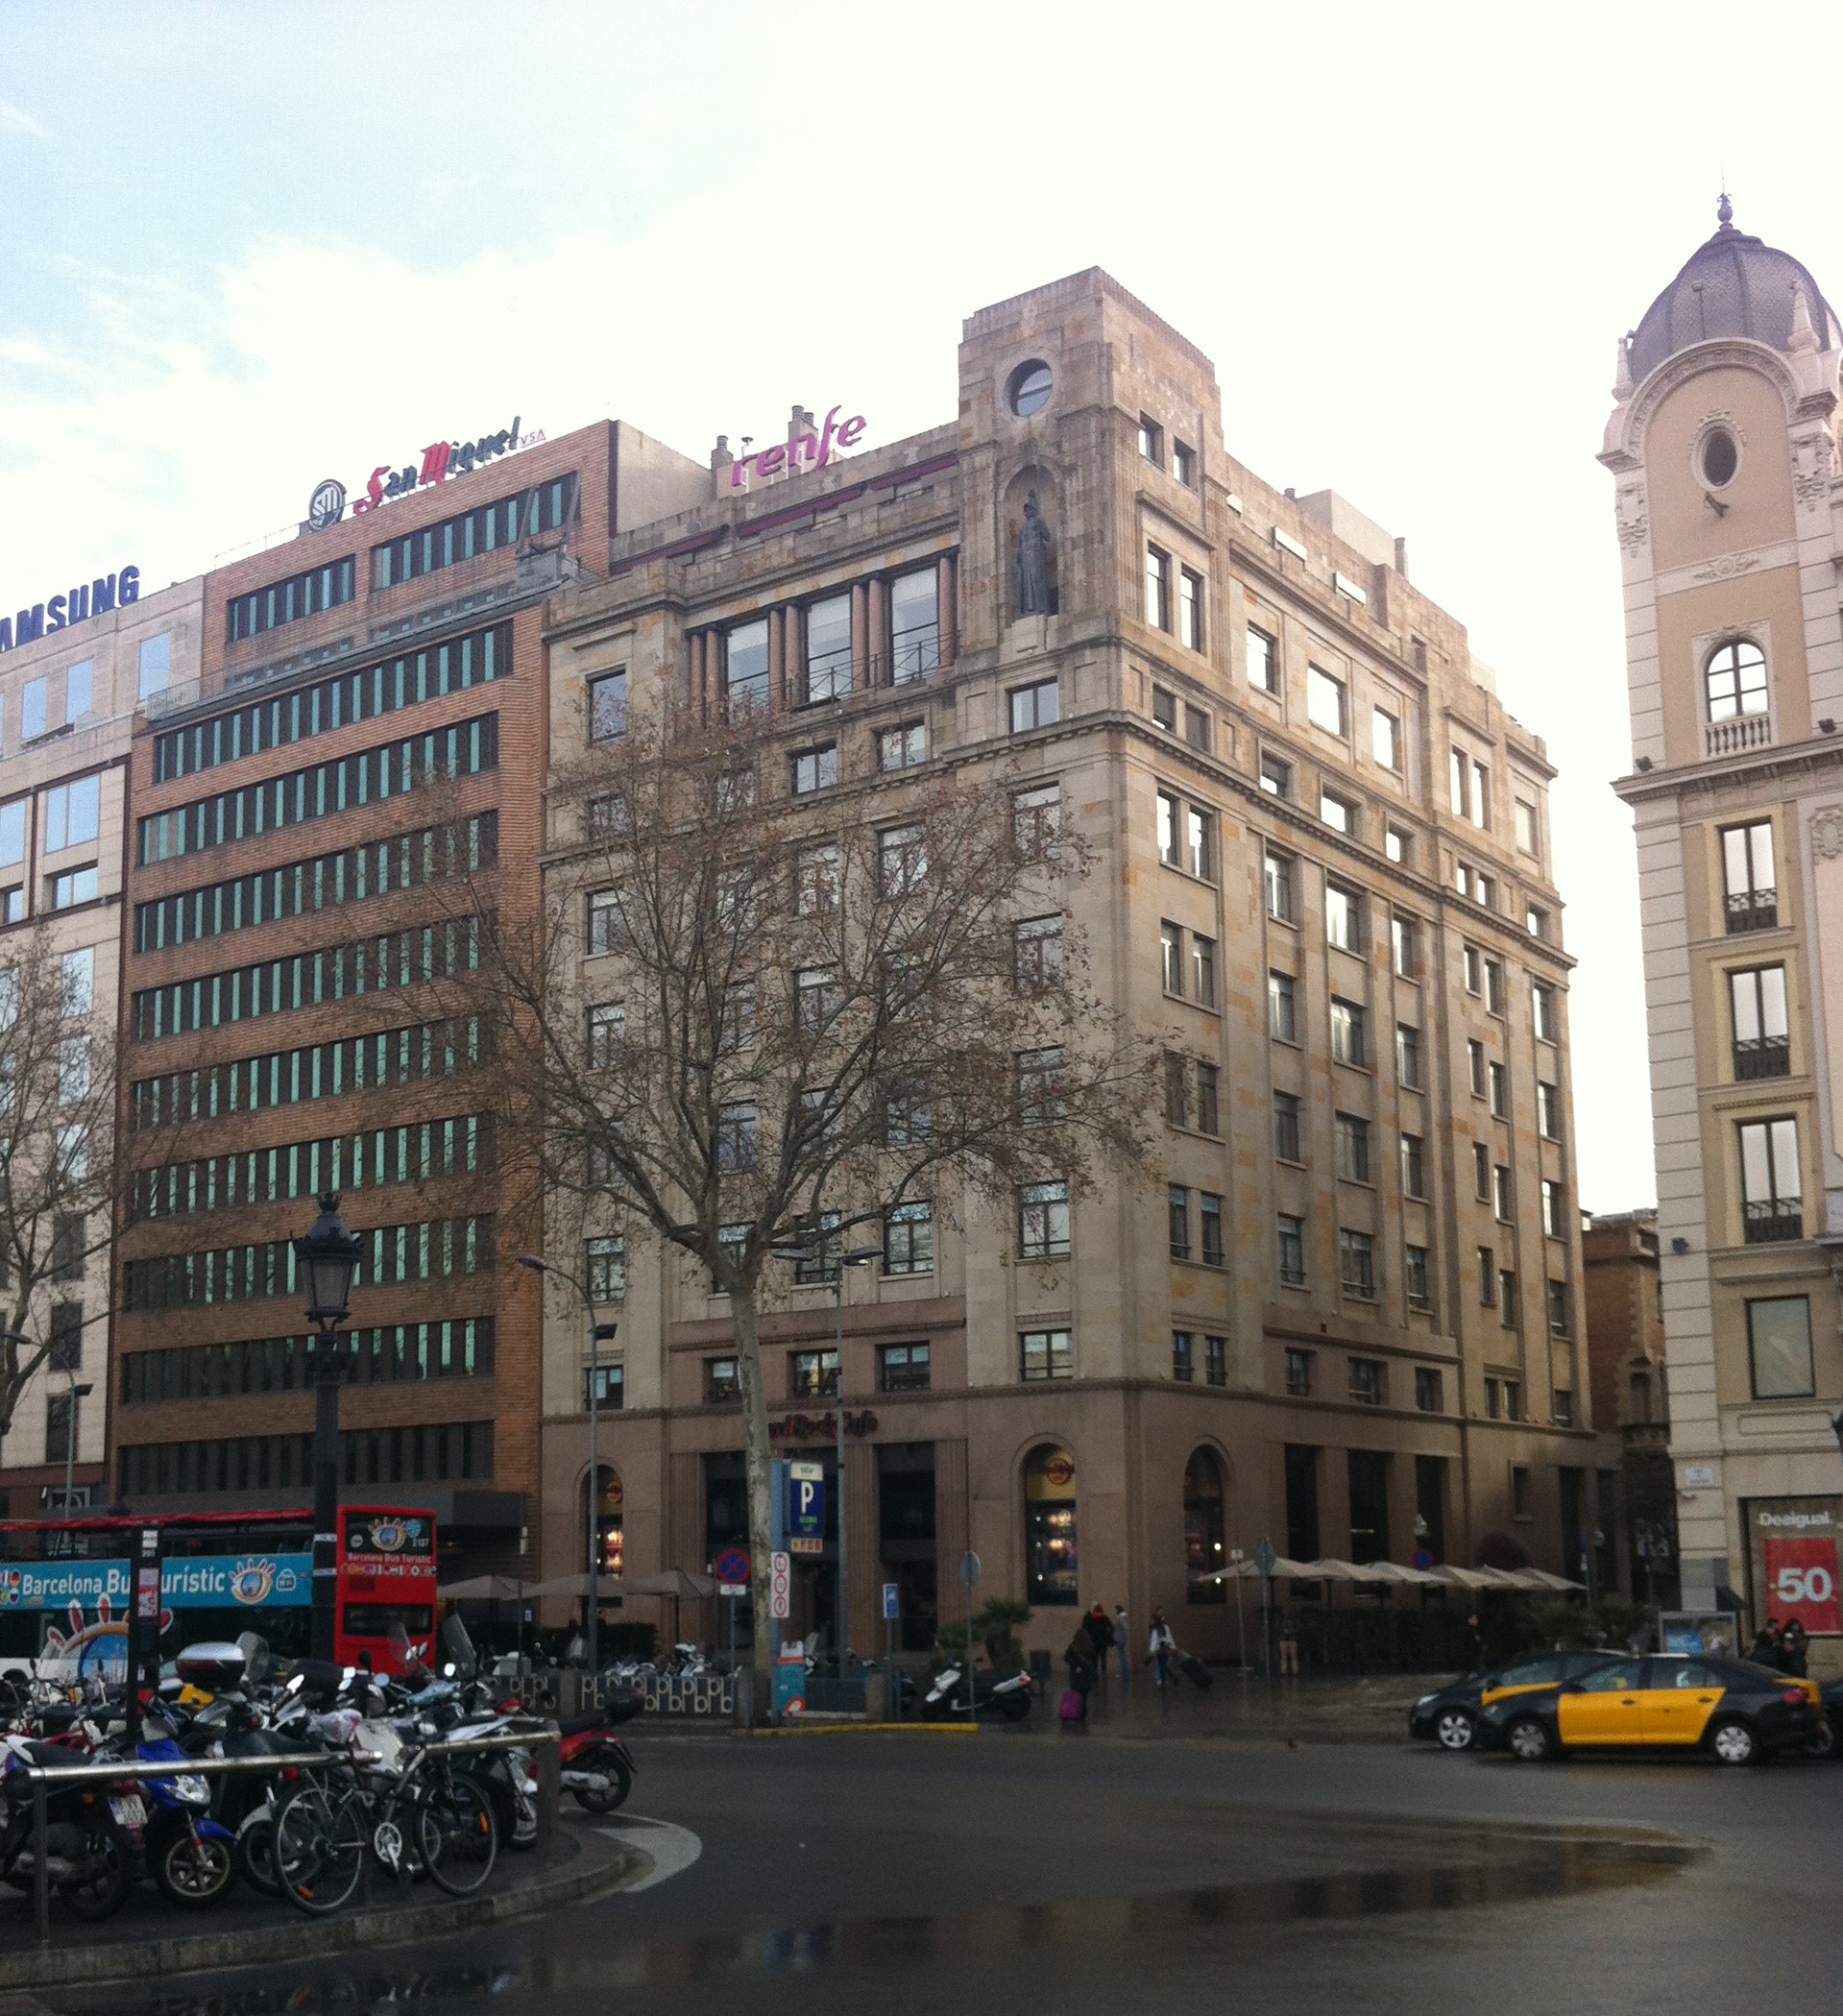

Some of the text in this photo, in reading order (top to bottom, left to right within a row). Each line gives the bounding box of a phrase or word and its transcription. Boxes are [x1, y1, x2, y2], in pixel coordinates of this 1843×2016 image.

[731, 404, 867, 487] renfe
[352, 465, 418, 517] San
[419, 415, 521, 487] Miguel
[0, 565, 140, 653] AMSUNG
[801, 1482, 814, 1514] P
[1759, 1511, 1830, 1529] Desigual
[385, 1553, 400, 1563] Bus
[22, 1566, 226, 1597] Barcelona Bu urístic
